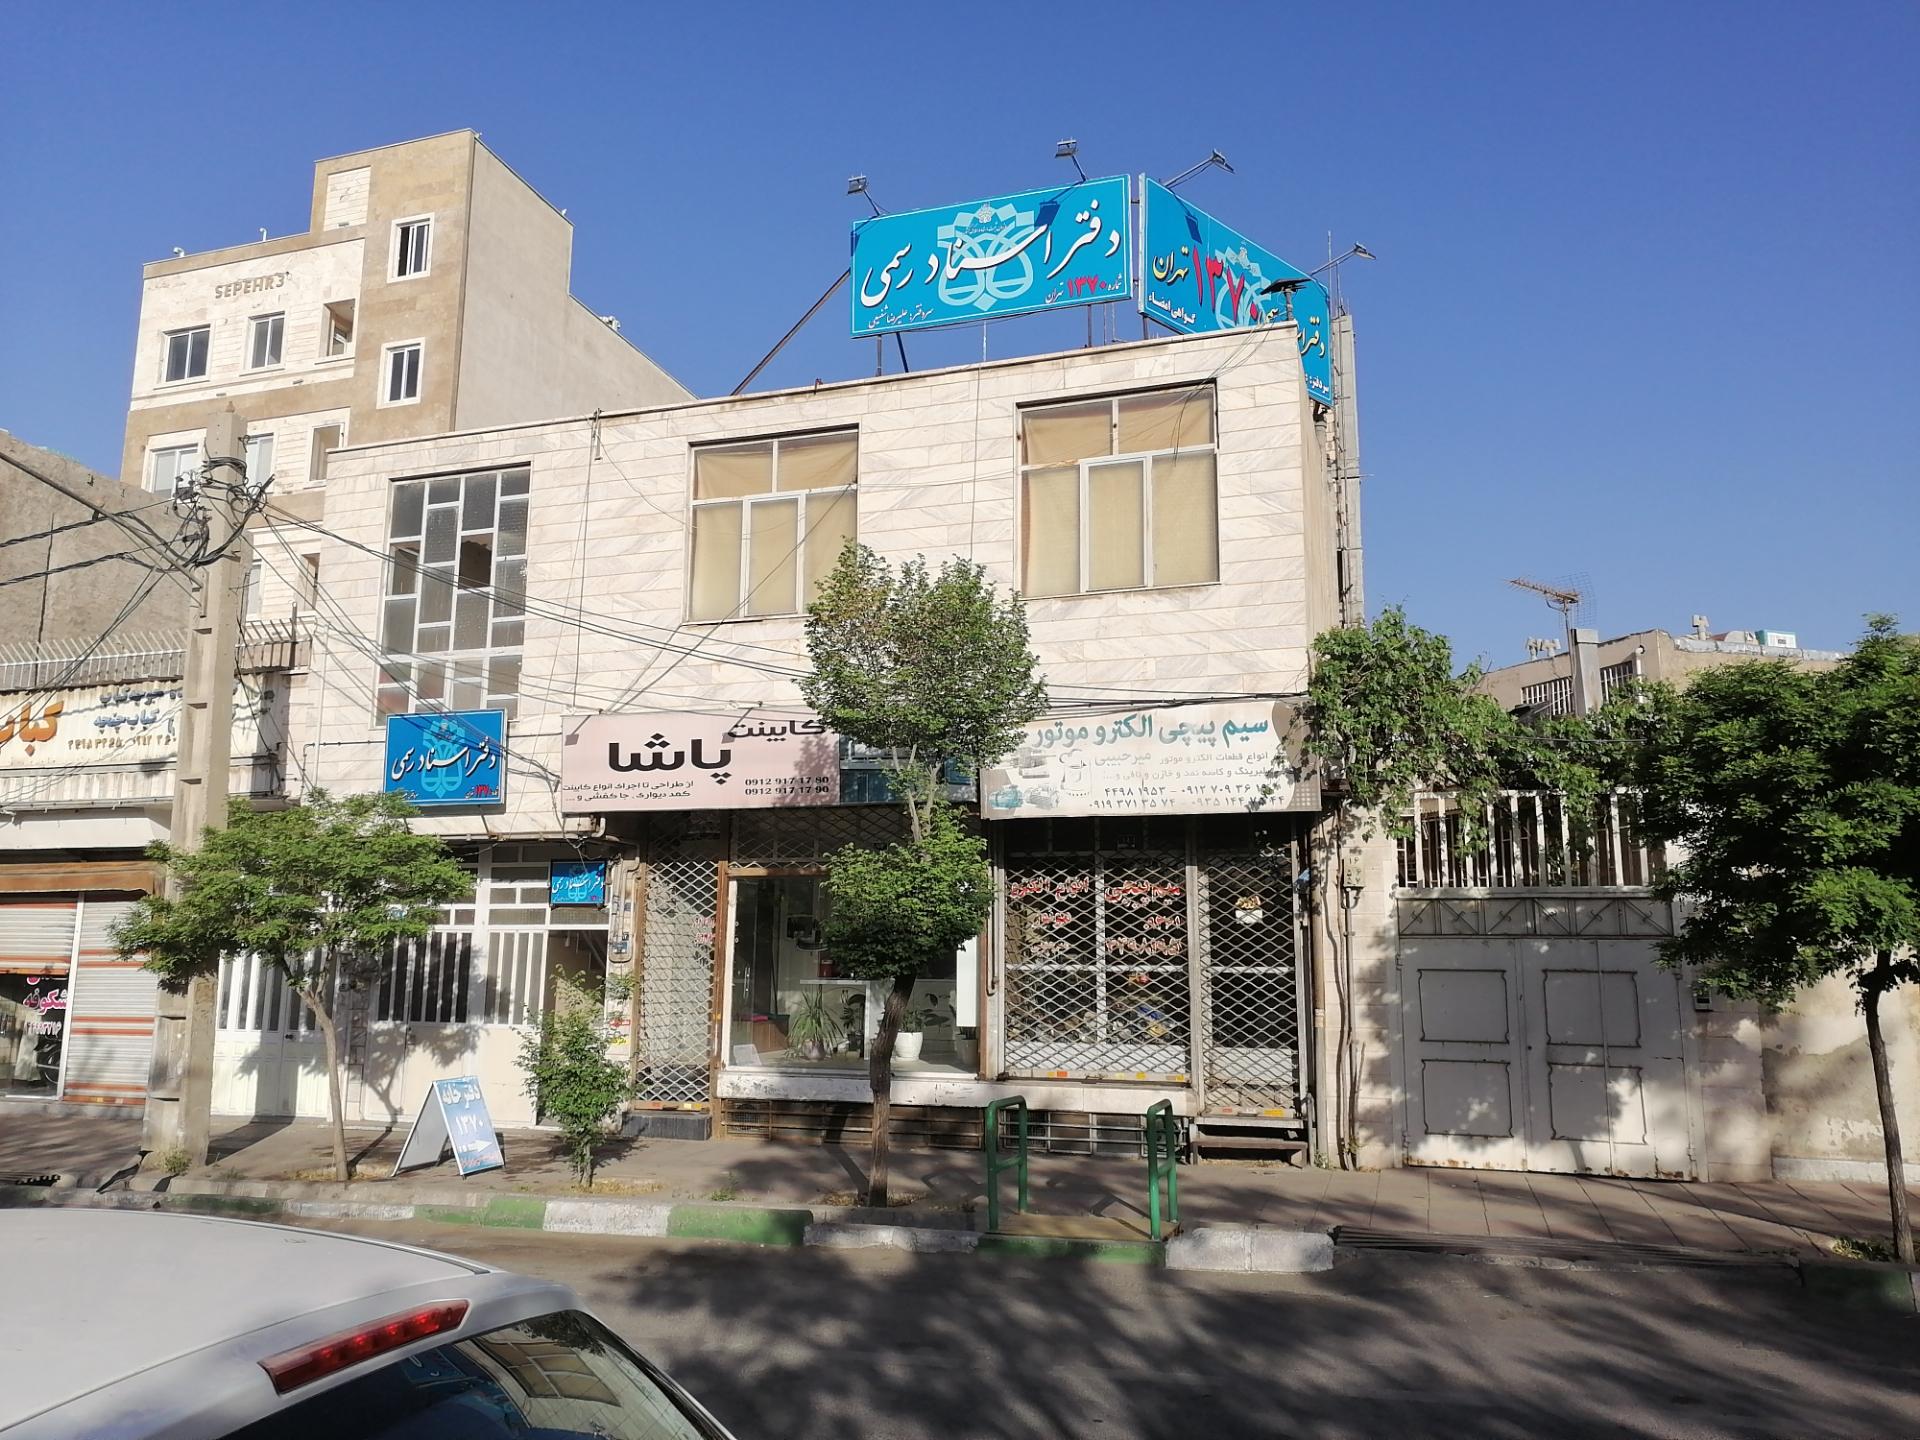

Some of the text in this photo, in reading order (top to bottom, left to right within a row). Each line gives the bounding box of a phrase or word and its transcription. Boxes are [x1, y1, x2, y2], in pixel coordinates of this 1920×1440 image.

[859, 198, 1121, 308] دفتر اسناد رسمی
[1067, 274, 1107, 298] ۱۳۷۰
[1152, 244, 1259, 323] تهران ۱۳۷۰
[1300, 315, 1326, 358] دفتر
[727, 720, 827, 742] کابینت
[1031, 712, 1269, 749] سیم پیچی الکترو موتور
[391, 747, 416, 781] رسمی
[417, 746, 470, 771] اسناد
[465, 736, 496, 777] دفتر
[608, 733, 733, 785] پاشا
[1246, 752, 1268, 764] انواع
[651, 780, 684, 790] طراحی
[745, 778, 771, 787] 0912
[775, 777, 796, 786] 917
[801, 776, 812, 785] 17
[745, 787, 771, 796] 0912
[775, 786, 796, 796] 917
[801, 785, 812, 794] 17
